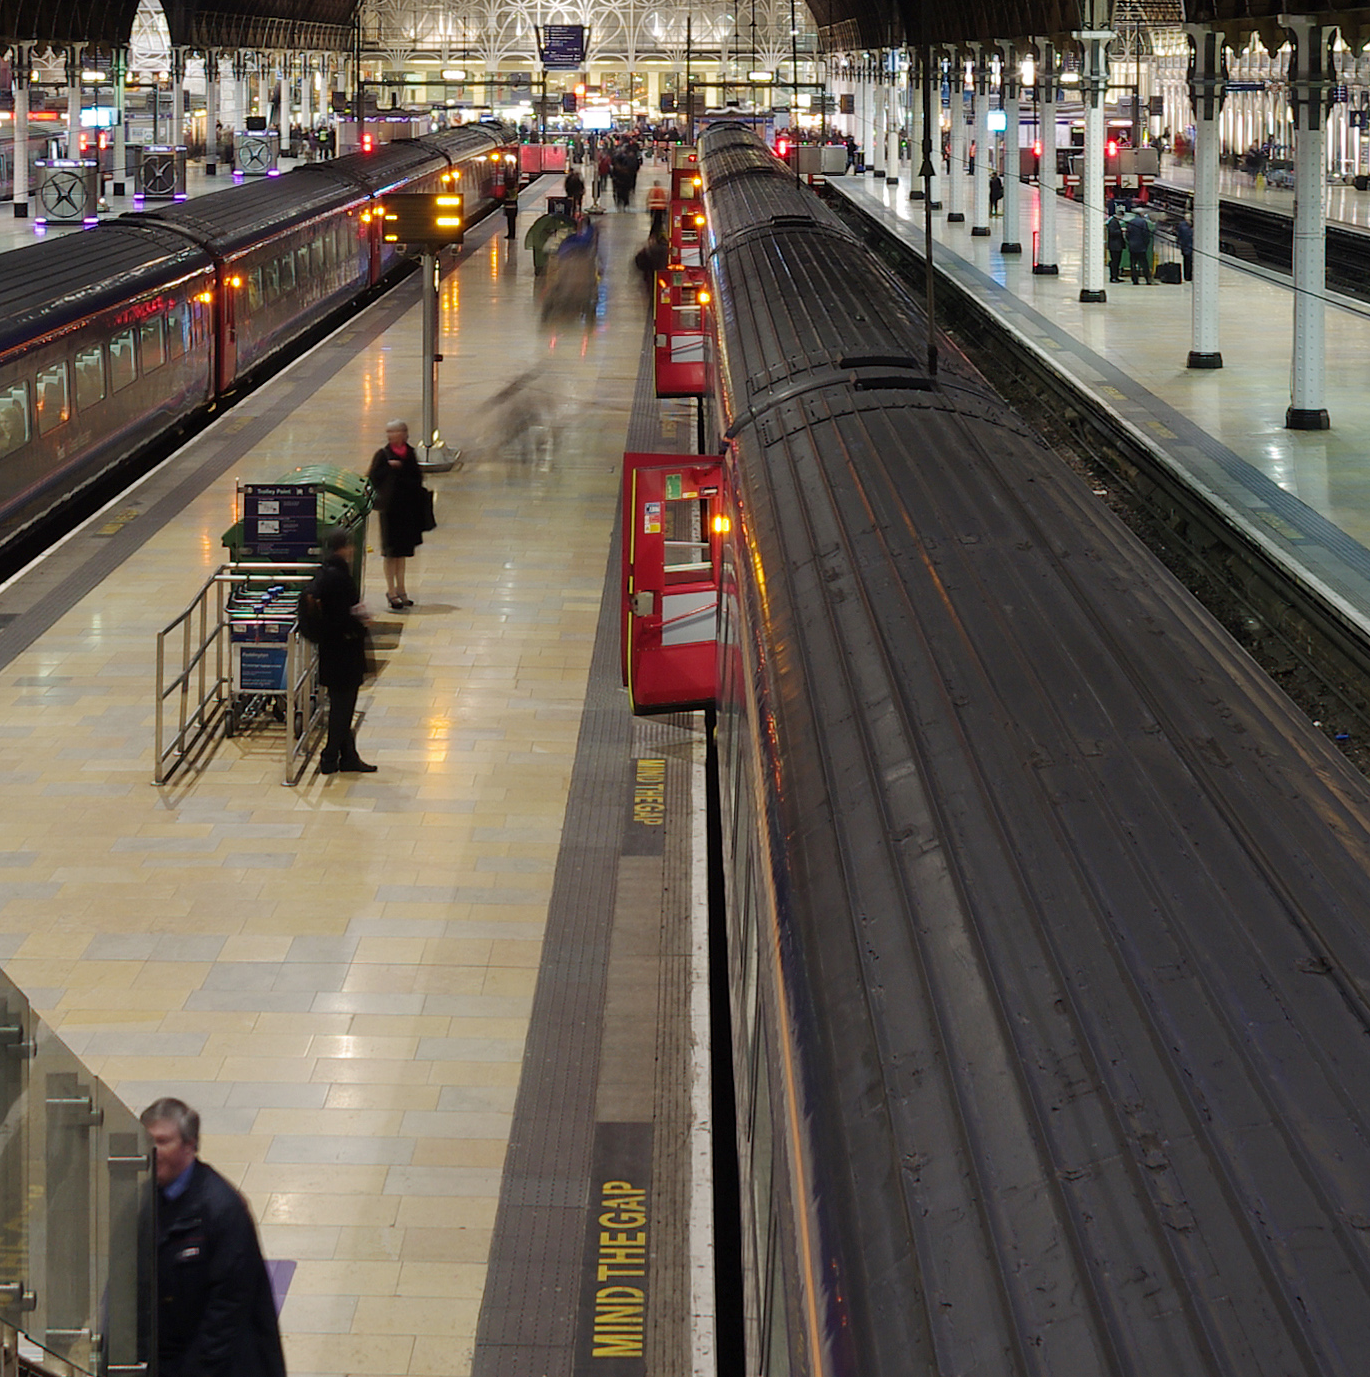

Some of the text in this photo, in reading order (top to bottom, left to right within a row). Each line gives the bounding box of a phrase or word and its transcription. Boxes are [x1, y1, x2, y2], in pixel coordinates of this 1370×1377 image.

[633, 758, 666, 825] MIND THE GAP
[592, 1180, 647, 1357] MIND THE GAP
